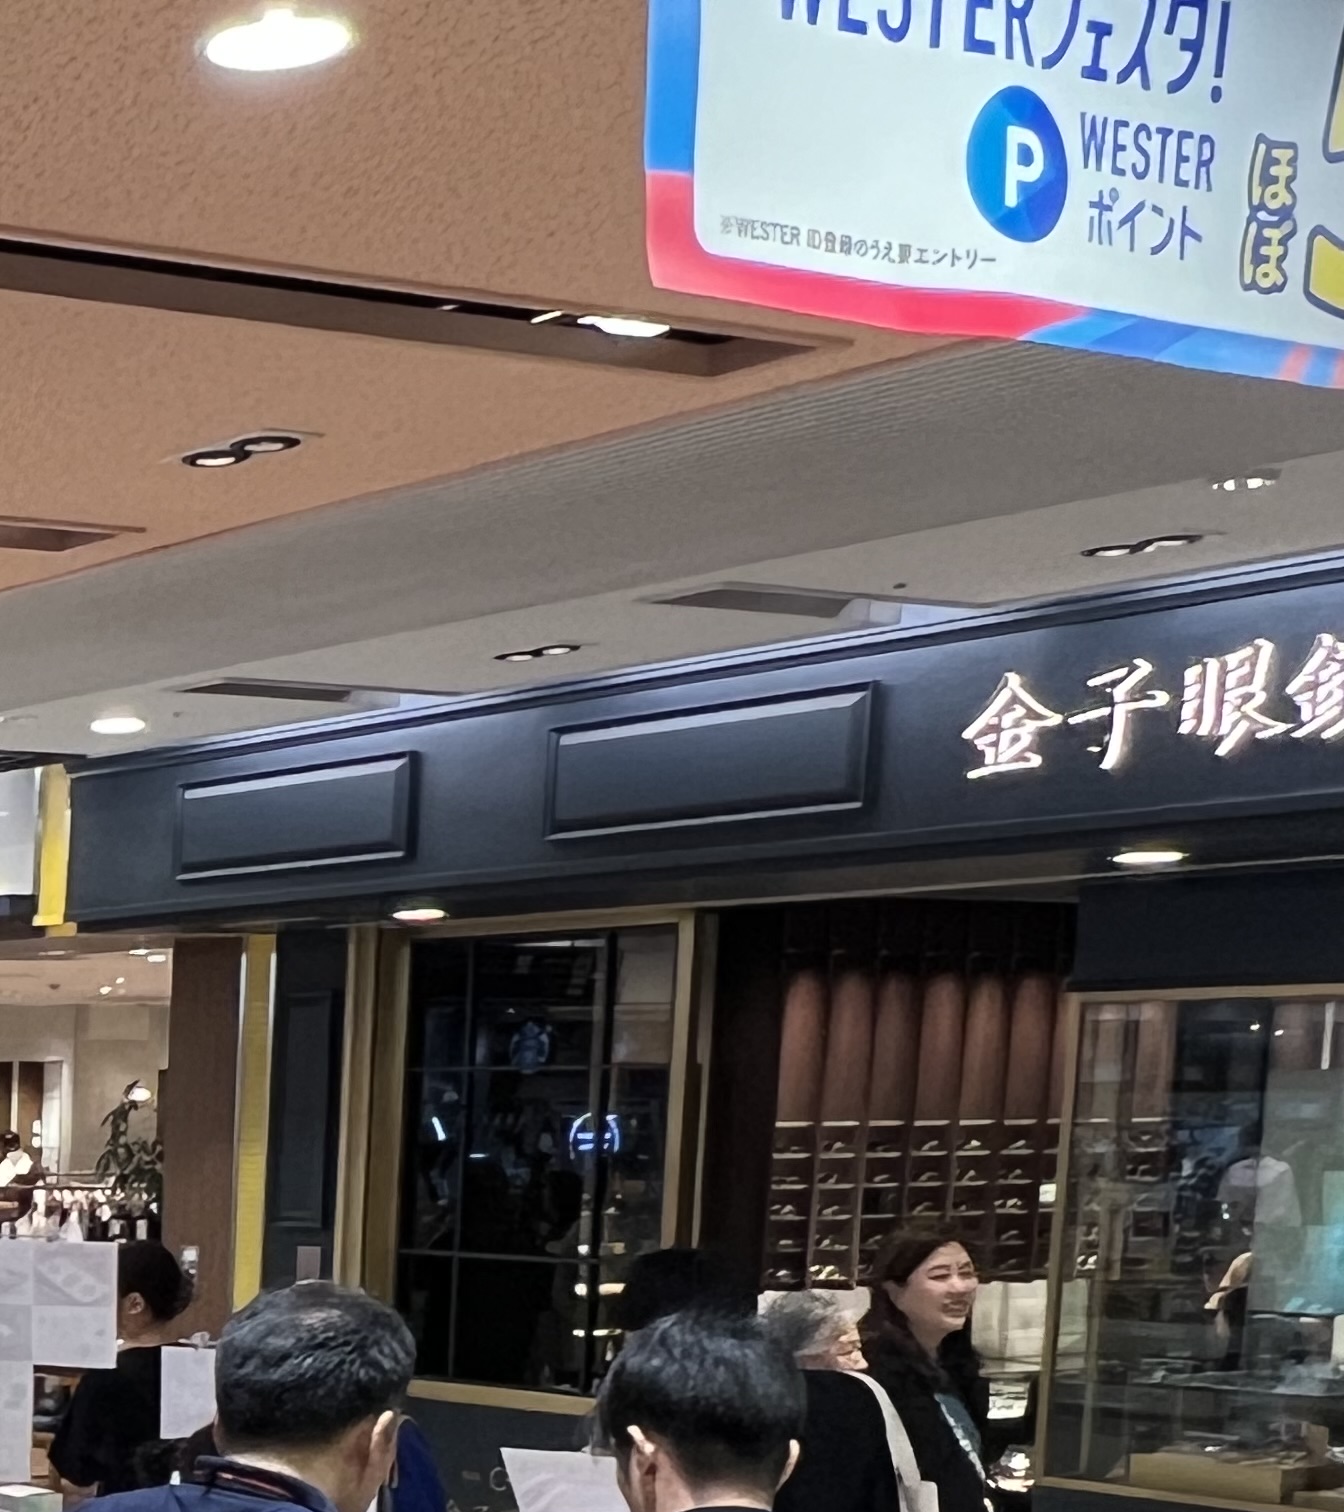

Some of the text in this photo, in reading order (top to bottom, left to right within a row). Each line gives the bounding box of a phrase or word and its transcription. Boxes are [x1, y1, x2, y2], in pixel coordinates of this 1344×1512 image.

[1079, 111, 1215, 192] WESTER
[1087, 189, 1203, 261] ポイント
